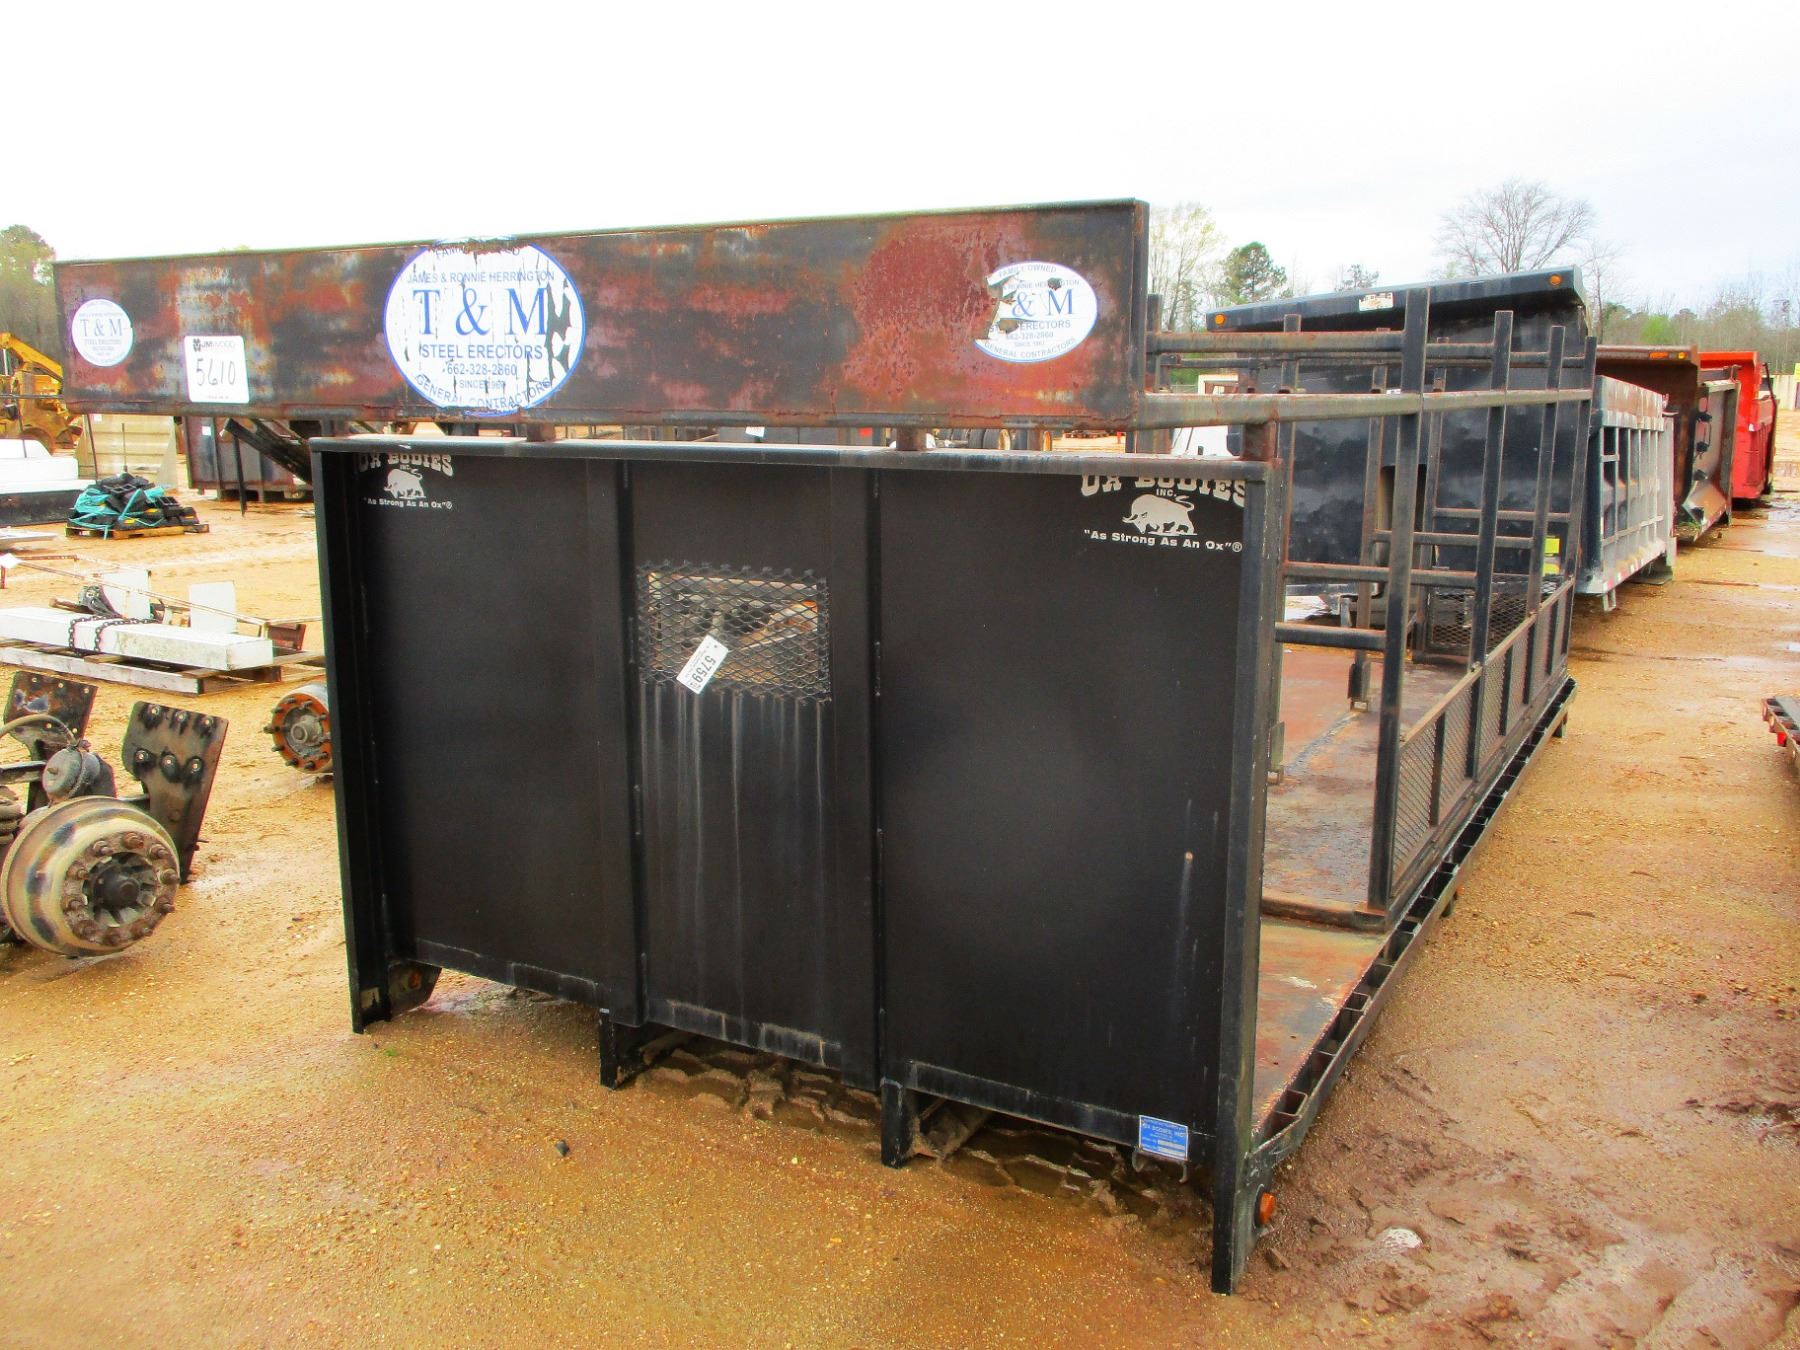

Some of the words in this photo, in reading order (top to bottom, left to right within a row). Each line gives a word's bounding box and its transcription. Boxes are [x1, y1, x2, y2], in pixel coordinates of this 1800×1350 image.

[1027, 264, 1057, 273] OWNED
[408, 272, 438, 284] JAMES
[441, 273, 447, 283] &
[450, 272, 487, 283] RONNIE
[489, 271, 555, 283] HERRINGTON
[1012, 291, 1035, 317] &
[1047, 288, 1074, 316] M
[413, 289, 441, 335] T
[456, 288, 489, 337] &
[506, 287, 548, 336] M
[79, 318, 90, 337] T
[94, 318, 105, 337] &
[108, 318, 123, 337] M
[1020, 319, 1072, 331] ERECTORS
[421, 345, 464, 359] STEEL
[468, 344, 543, 360] ERECTORS
[984, 341, 1018, 358] GENERAL
[1020, 337, 1077, 359] CONTRACTORS
[195, 357, 236, 386] 5610
[447, 362, 518, 376] 662-328-2860
[415, 374, 463, 404] GENERAL
[470, 376, 552, 410] CONTRACTORS
[459, 379, 485, 390] SINCE
[1156, 488, 1178, 497] INC.
[379, 498, 404, 508] Strong
[406, 499, 417, 507] As
[418, 500, 429, 508] An
[1111, 532, 1156, 546] Strong
[1160, 537, 1178, 547] As
[1182, 538, 1200, 549] An
[691, 655, 717, 683] 5759
